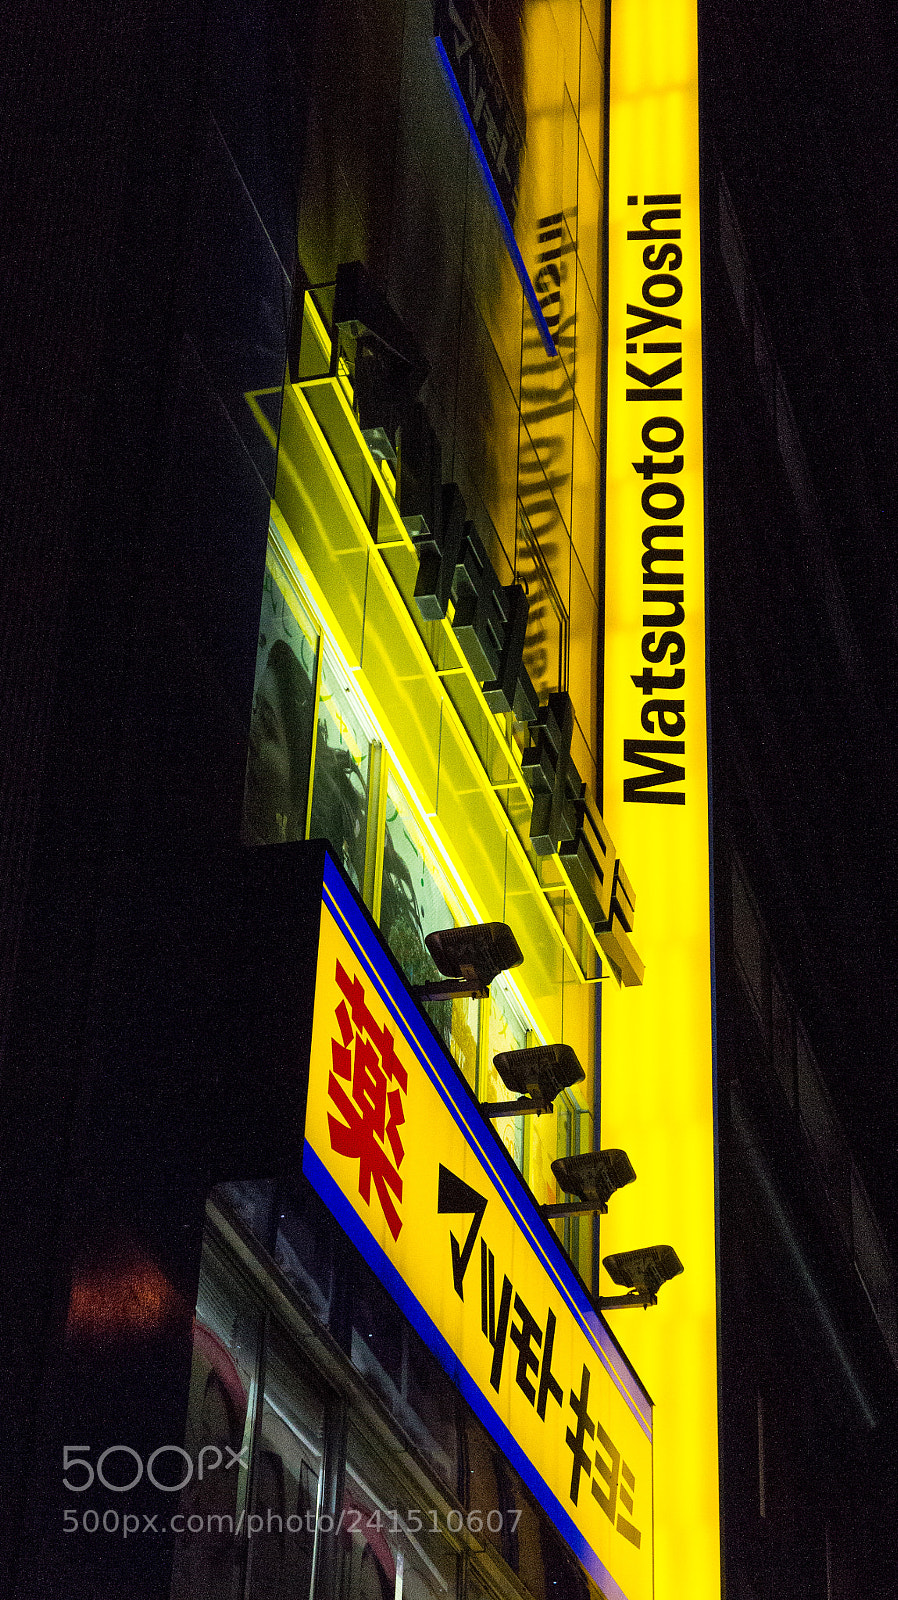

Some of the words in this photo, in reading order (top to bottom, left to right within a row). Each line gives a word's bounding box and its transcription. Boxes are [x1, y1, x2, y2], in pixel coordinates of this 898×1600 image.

[626, 194, 683, 402] KiYoshi
[623, 416, 686, 806] Matsumoto
[327, 958, 409, 1242] 薬
